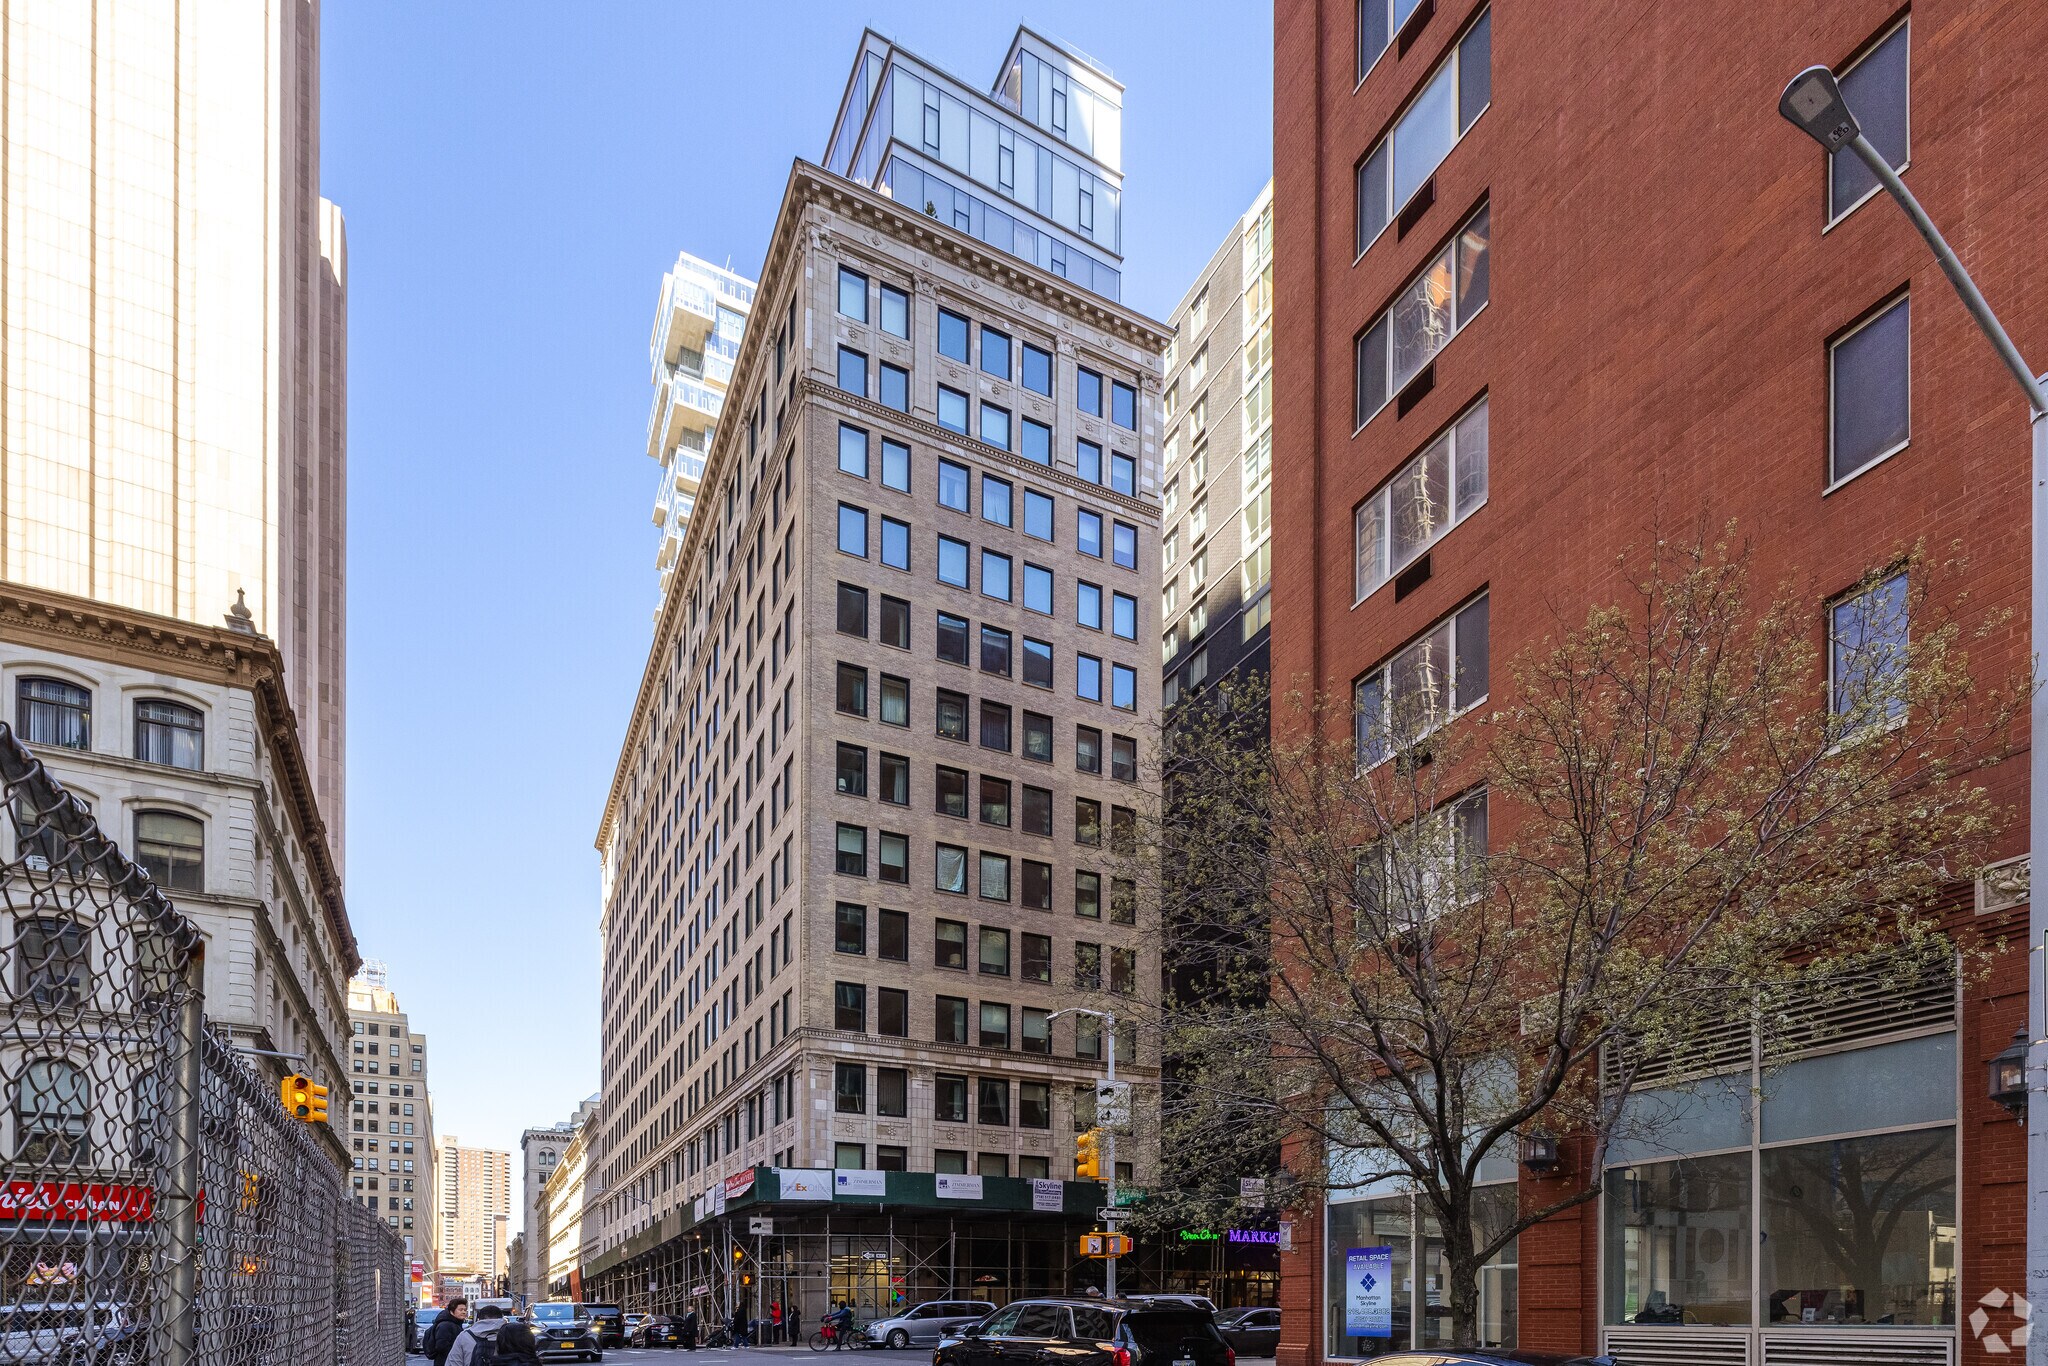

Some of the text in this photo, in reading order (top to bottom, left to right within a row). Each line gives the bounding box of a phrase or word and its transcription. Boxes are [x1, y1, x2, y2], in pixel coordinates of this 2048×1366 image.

[1833, 127, 1849, 141] LED
[782, 1182, 807, 1192] FedEx
[1038, 1181, 1062, 1191] Skyline
[65, 1200, 120, 1211] CUBAN
[1369, 1253, 1389, 1261] SPACE
[1353, 1262, 1384, 1270] AVAILABLE
